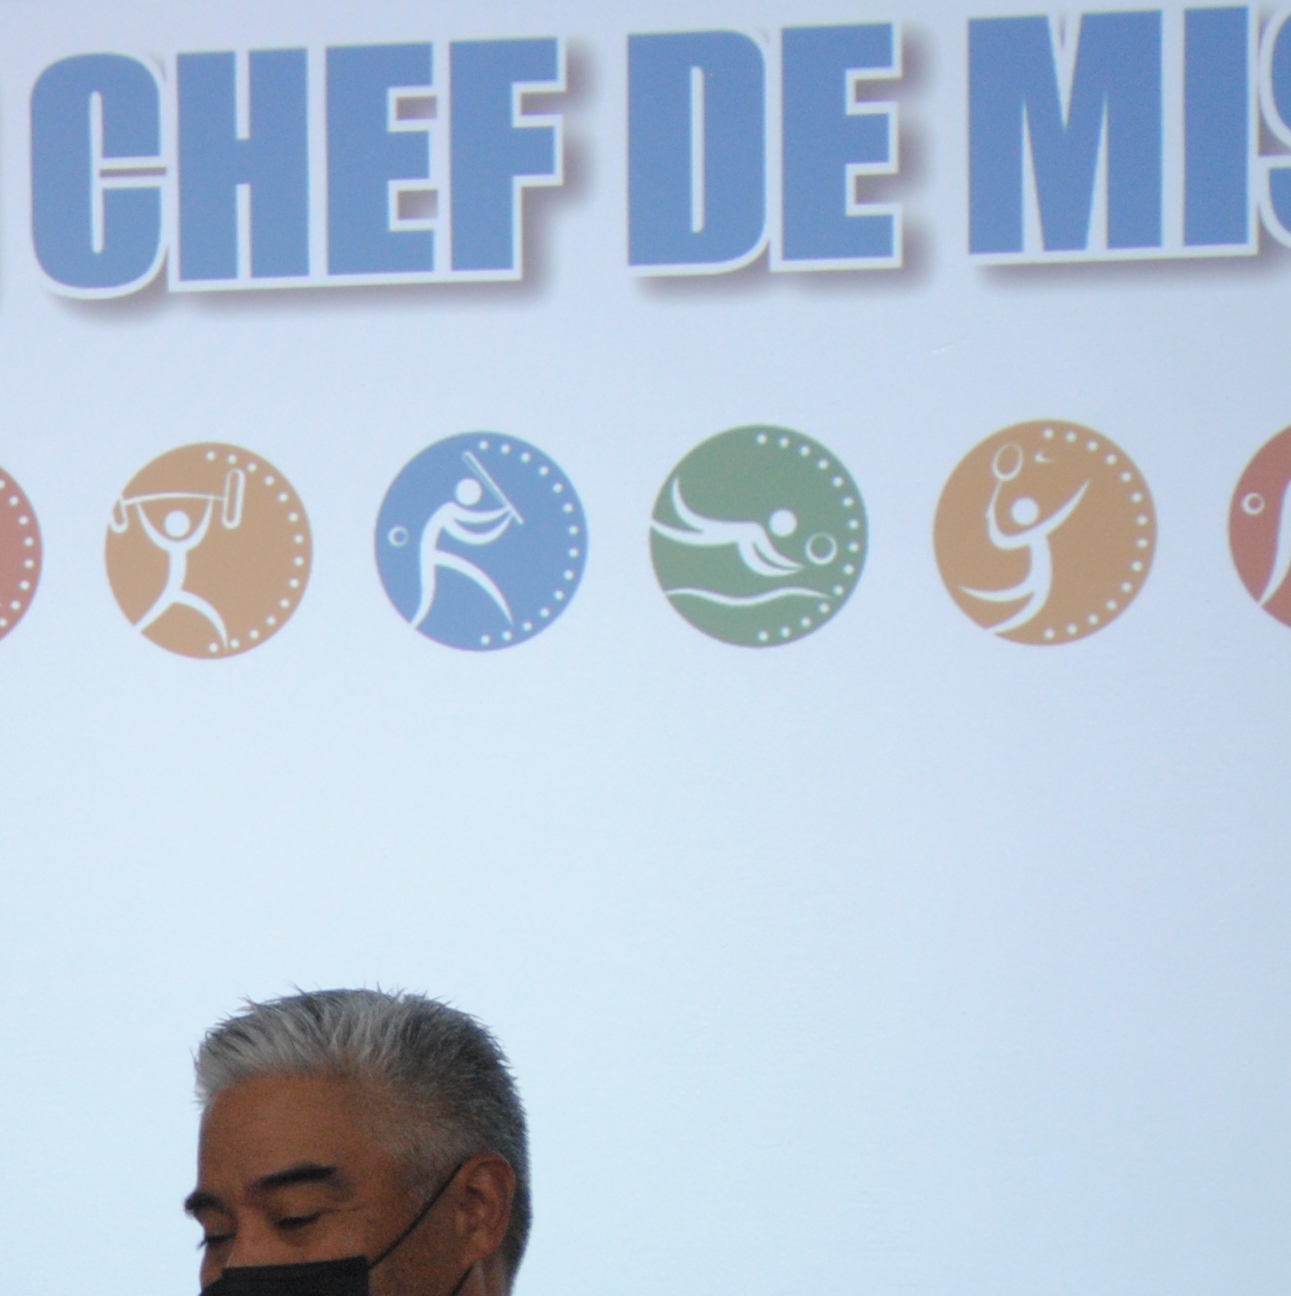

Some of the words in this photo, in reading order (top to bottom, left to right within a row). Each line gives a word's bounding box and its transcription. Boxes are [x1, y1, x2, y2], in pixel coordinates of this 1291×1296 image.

[27, 36, 562, 293] CHEF
[625, 20, 898, 271] DE
[965, 5, 1291, 258] MI
